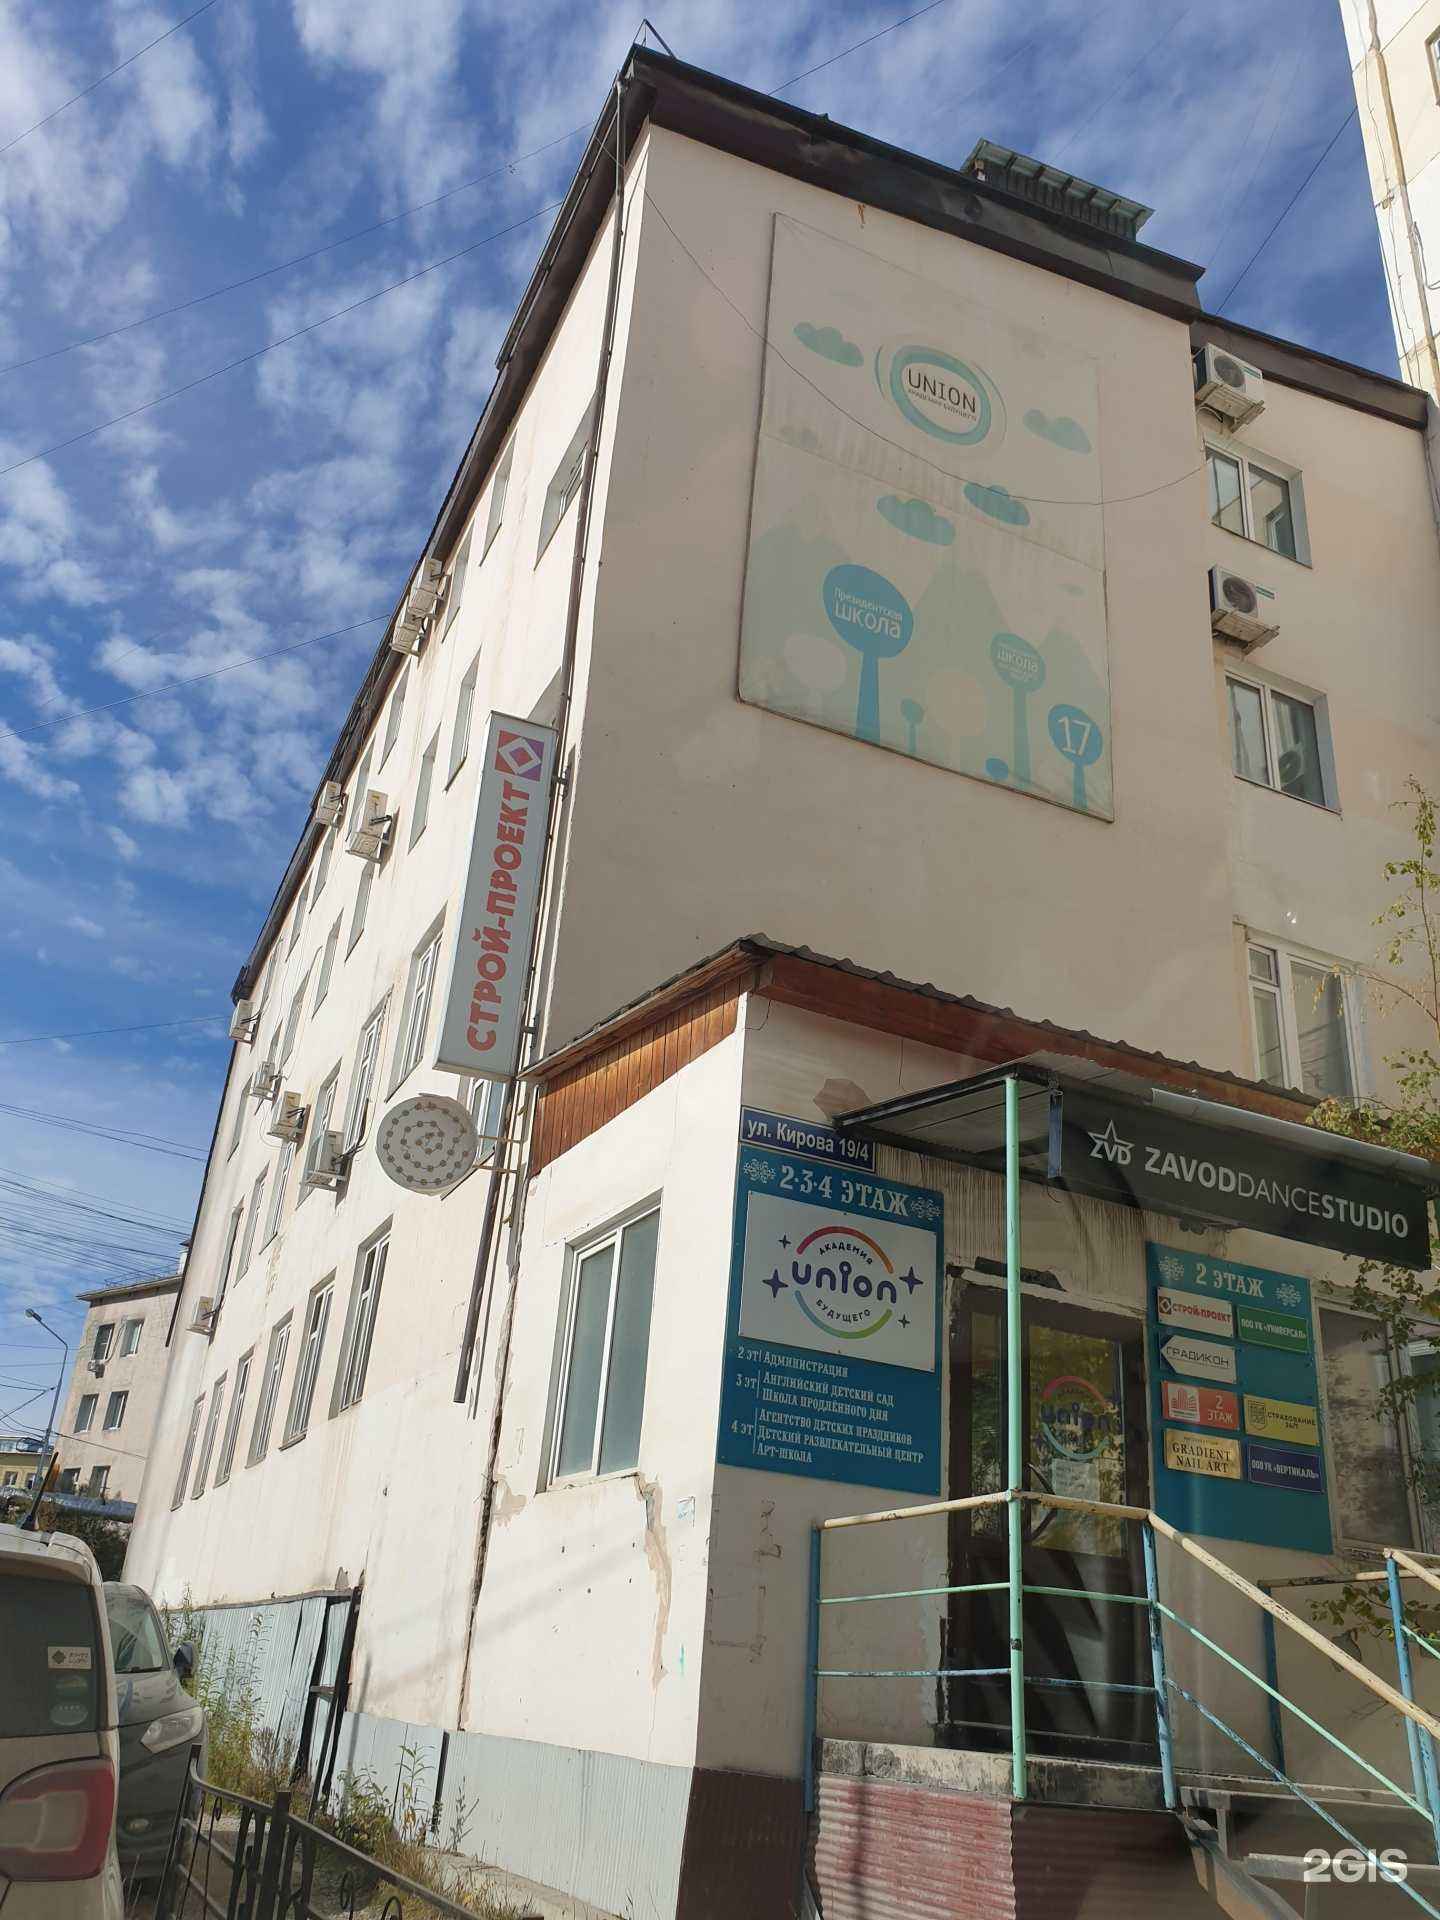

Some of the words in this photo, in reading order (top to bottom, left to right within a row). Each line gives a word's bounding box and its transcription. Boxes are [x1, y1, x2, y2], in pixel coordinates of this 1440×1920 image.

[907, 368, 976, 413] UNION
[1058, 716, 1092, 756] 17
[466, 779, 530, 1053] СТРОЙ-ПРОЕКТ
[747, 1119, 772, 1138] ул.
[776, 1122, 834, 1153] Кирова
[839, 1138, 869, 1161] 19/4
[840, 1179, 909, 1217] ЭТАЖ
[819, 1241, 873, 1265] АКАДЕМИЯ
[791, 1261, 897, 1304] union
[1196, 1263, 1208, 1285] 2
[1213, 1270, 1265, 1298] ЭТАЖ
[816, 1299, 871, 1324] БУДУЩЕГО
[1207, 1408, 1233, 1424] ЭТАЖ
[1215, 1395, 1224, 1410] 2
[1172, 1441, 1232, 1463] GRADIENT
[1176, 1456, 1200, 1470] NAIL
[1207, 1460, 1230, 1473] ART
